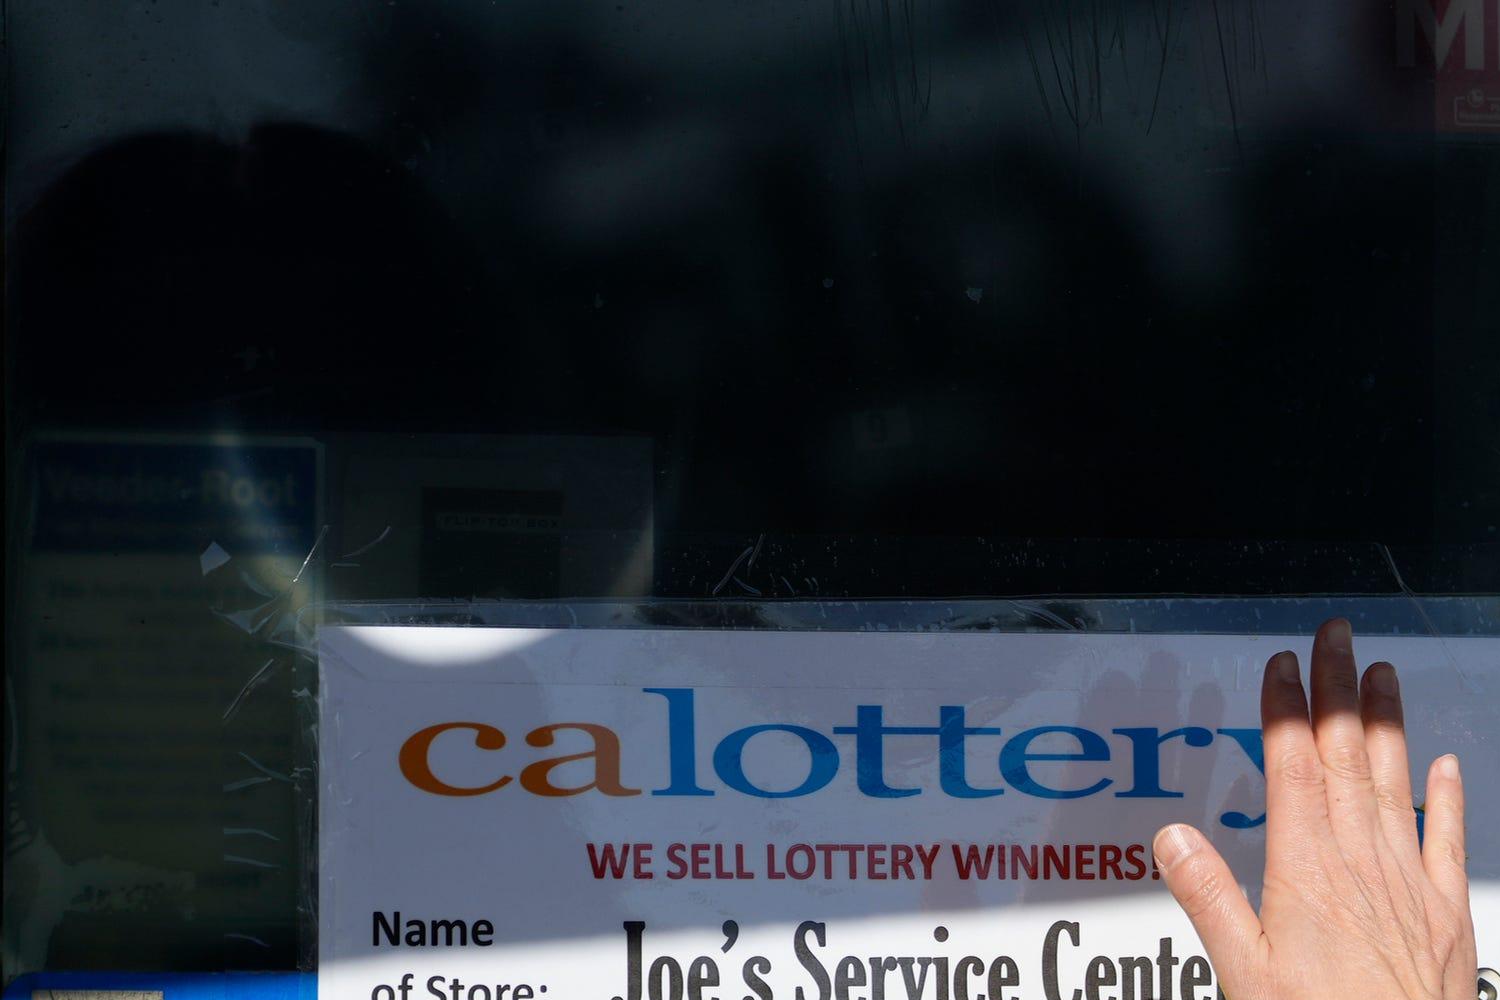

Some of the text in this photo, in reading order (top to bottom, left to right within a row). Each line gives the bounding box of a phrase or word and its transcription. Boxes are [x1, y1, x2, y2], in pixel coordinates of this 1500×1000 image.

[587, 843, 653, 880] WE
[667, 843, 754, 880] SELL
[767, 844, 940, 881] LOTTERY
[373, 912, 494, 947] Name
